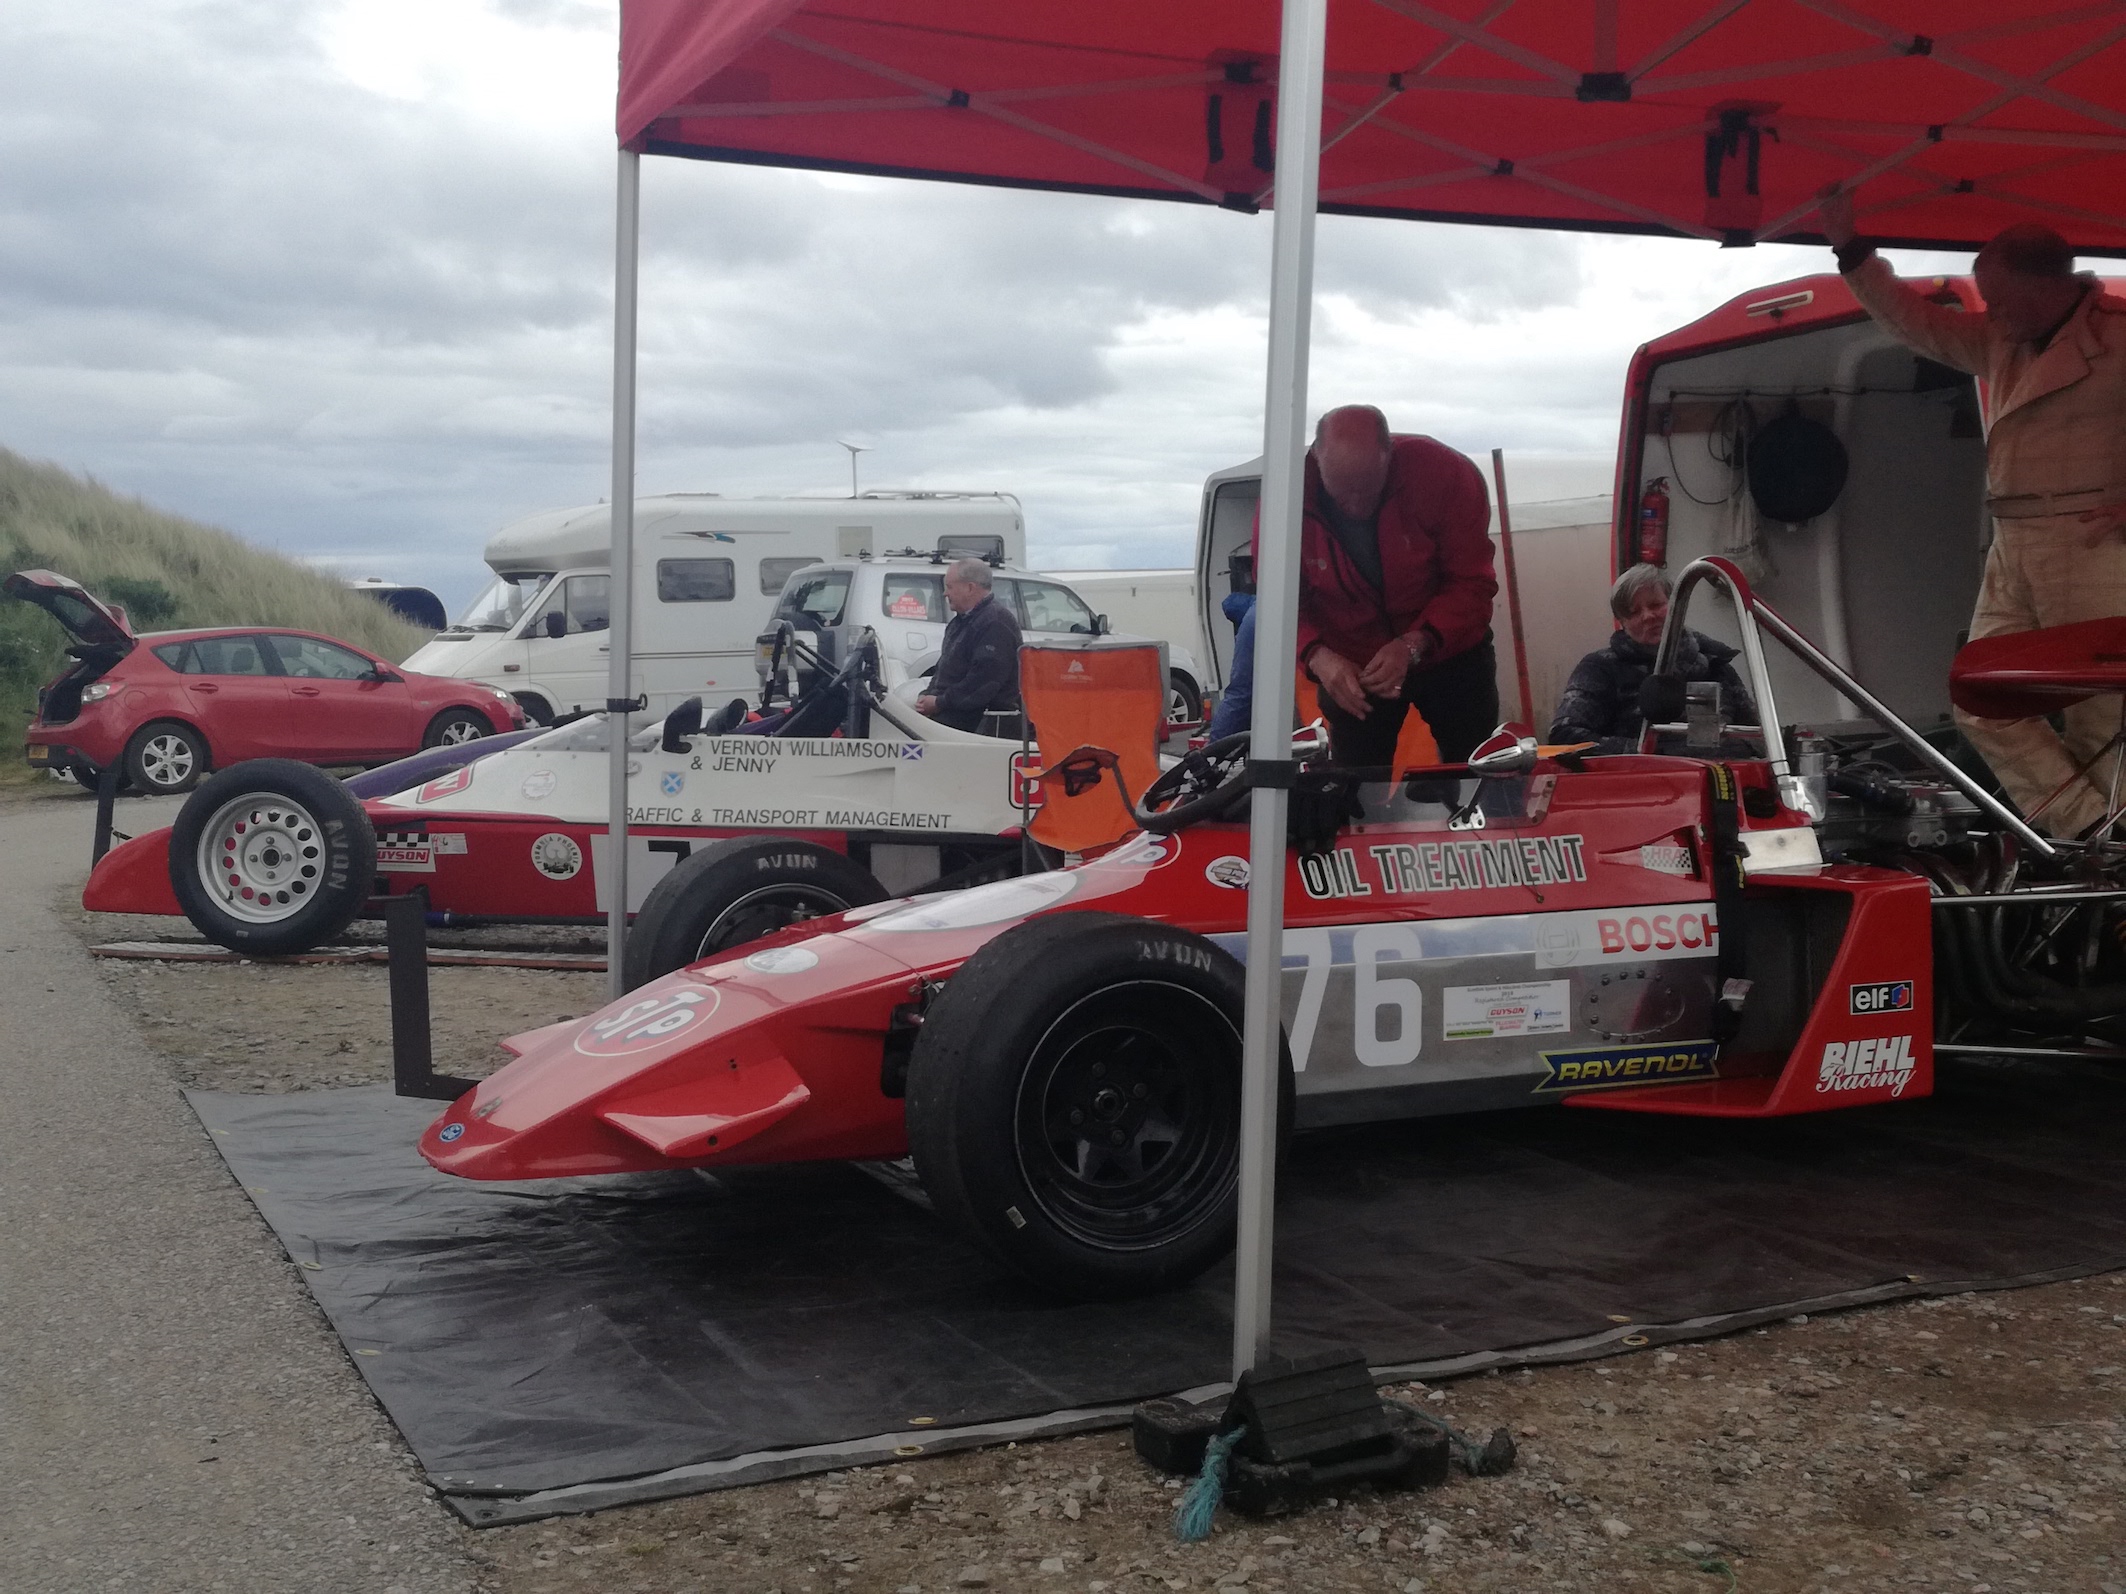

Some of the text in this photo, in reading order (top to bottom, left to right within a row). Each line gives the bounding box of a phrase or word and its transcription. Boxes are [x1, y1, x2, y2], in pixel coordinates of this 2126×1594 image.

[711, 740, 899, 758] VERNON WILLIAMSON
[691, 758, 776, 773] & JENNY
[625, 807, 951, 828] RAFFIC & TRANSPORT MANAGEMENT
[324, 820, 350, 889] AVON
[376, 850, 427, 861] UYSON
[756, 854, 818, 871] AVON
[1298, 834, 1587, 900] OIL TREATMENT
[1142, 940, 1212, 973] AVON
[1281, 926, 1423, 1073] 76
[1490, 1007, 1526, 1016] GUYSON
[1855, 987, 1889, 1010] elf
[594, 990, 707, 1040] STP
[1558, 1052, 1705, 1081] RAVENOL
[1816, 1063, 1917, 1097] Racing
